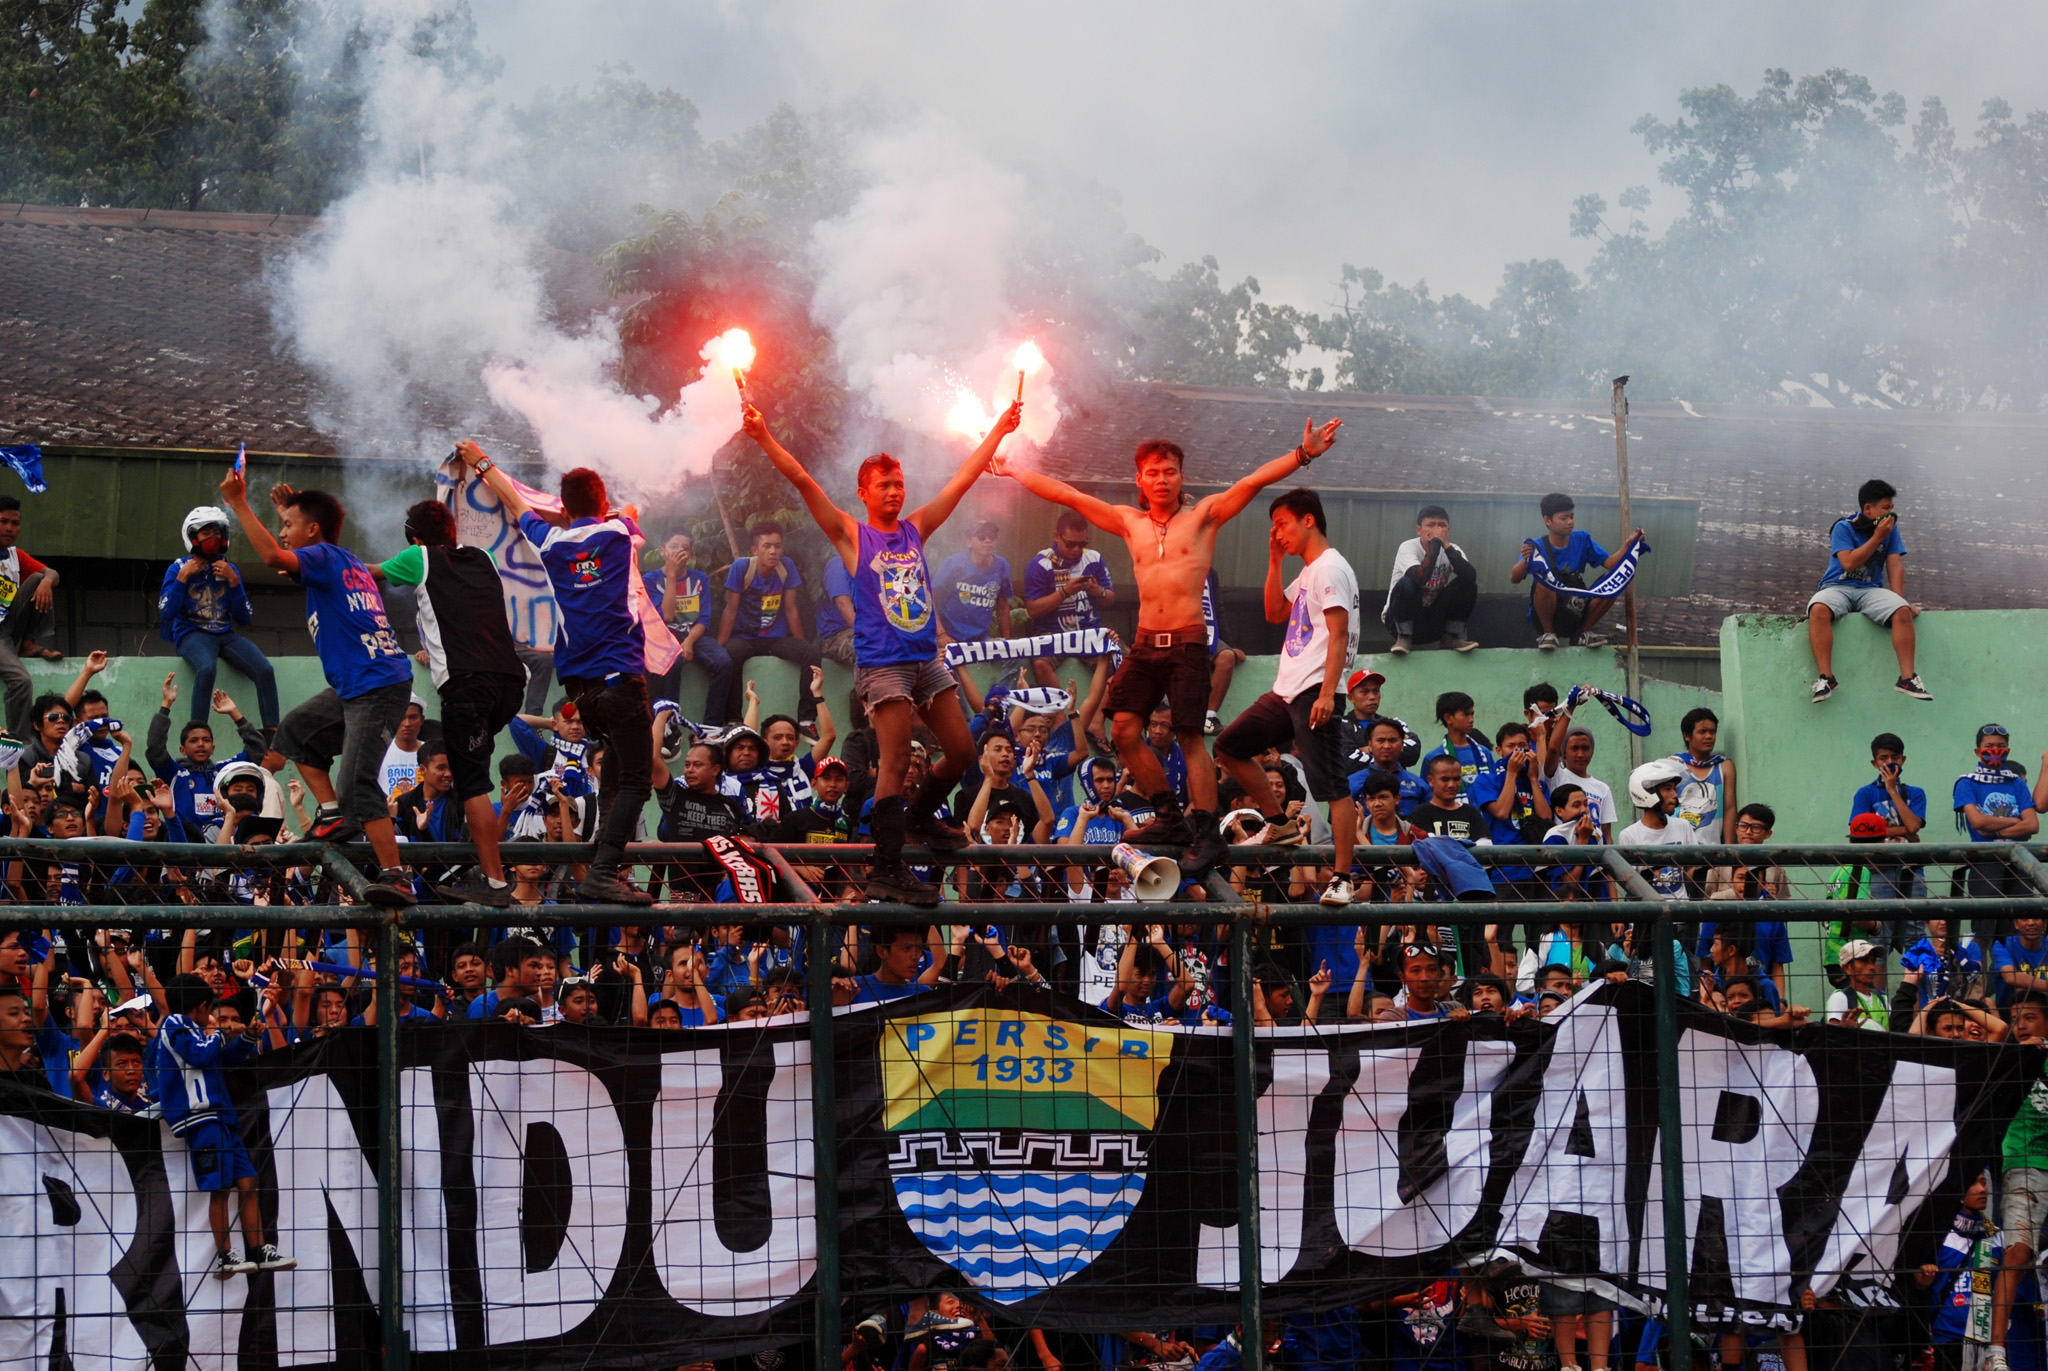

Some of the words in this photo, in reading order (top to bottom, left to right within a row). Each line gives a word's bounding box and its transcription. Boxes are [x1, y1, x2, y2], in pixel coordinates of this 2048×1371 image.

[945, 627, 1109, 666] CHAMPION
[388, 768, 417, 778] BAND
[970, 1053, 1076, 1084] 1933
[1197, 1003, 1958, 1305] JUARA
